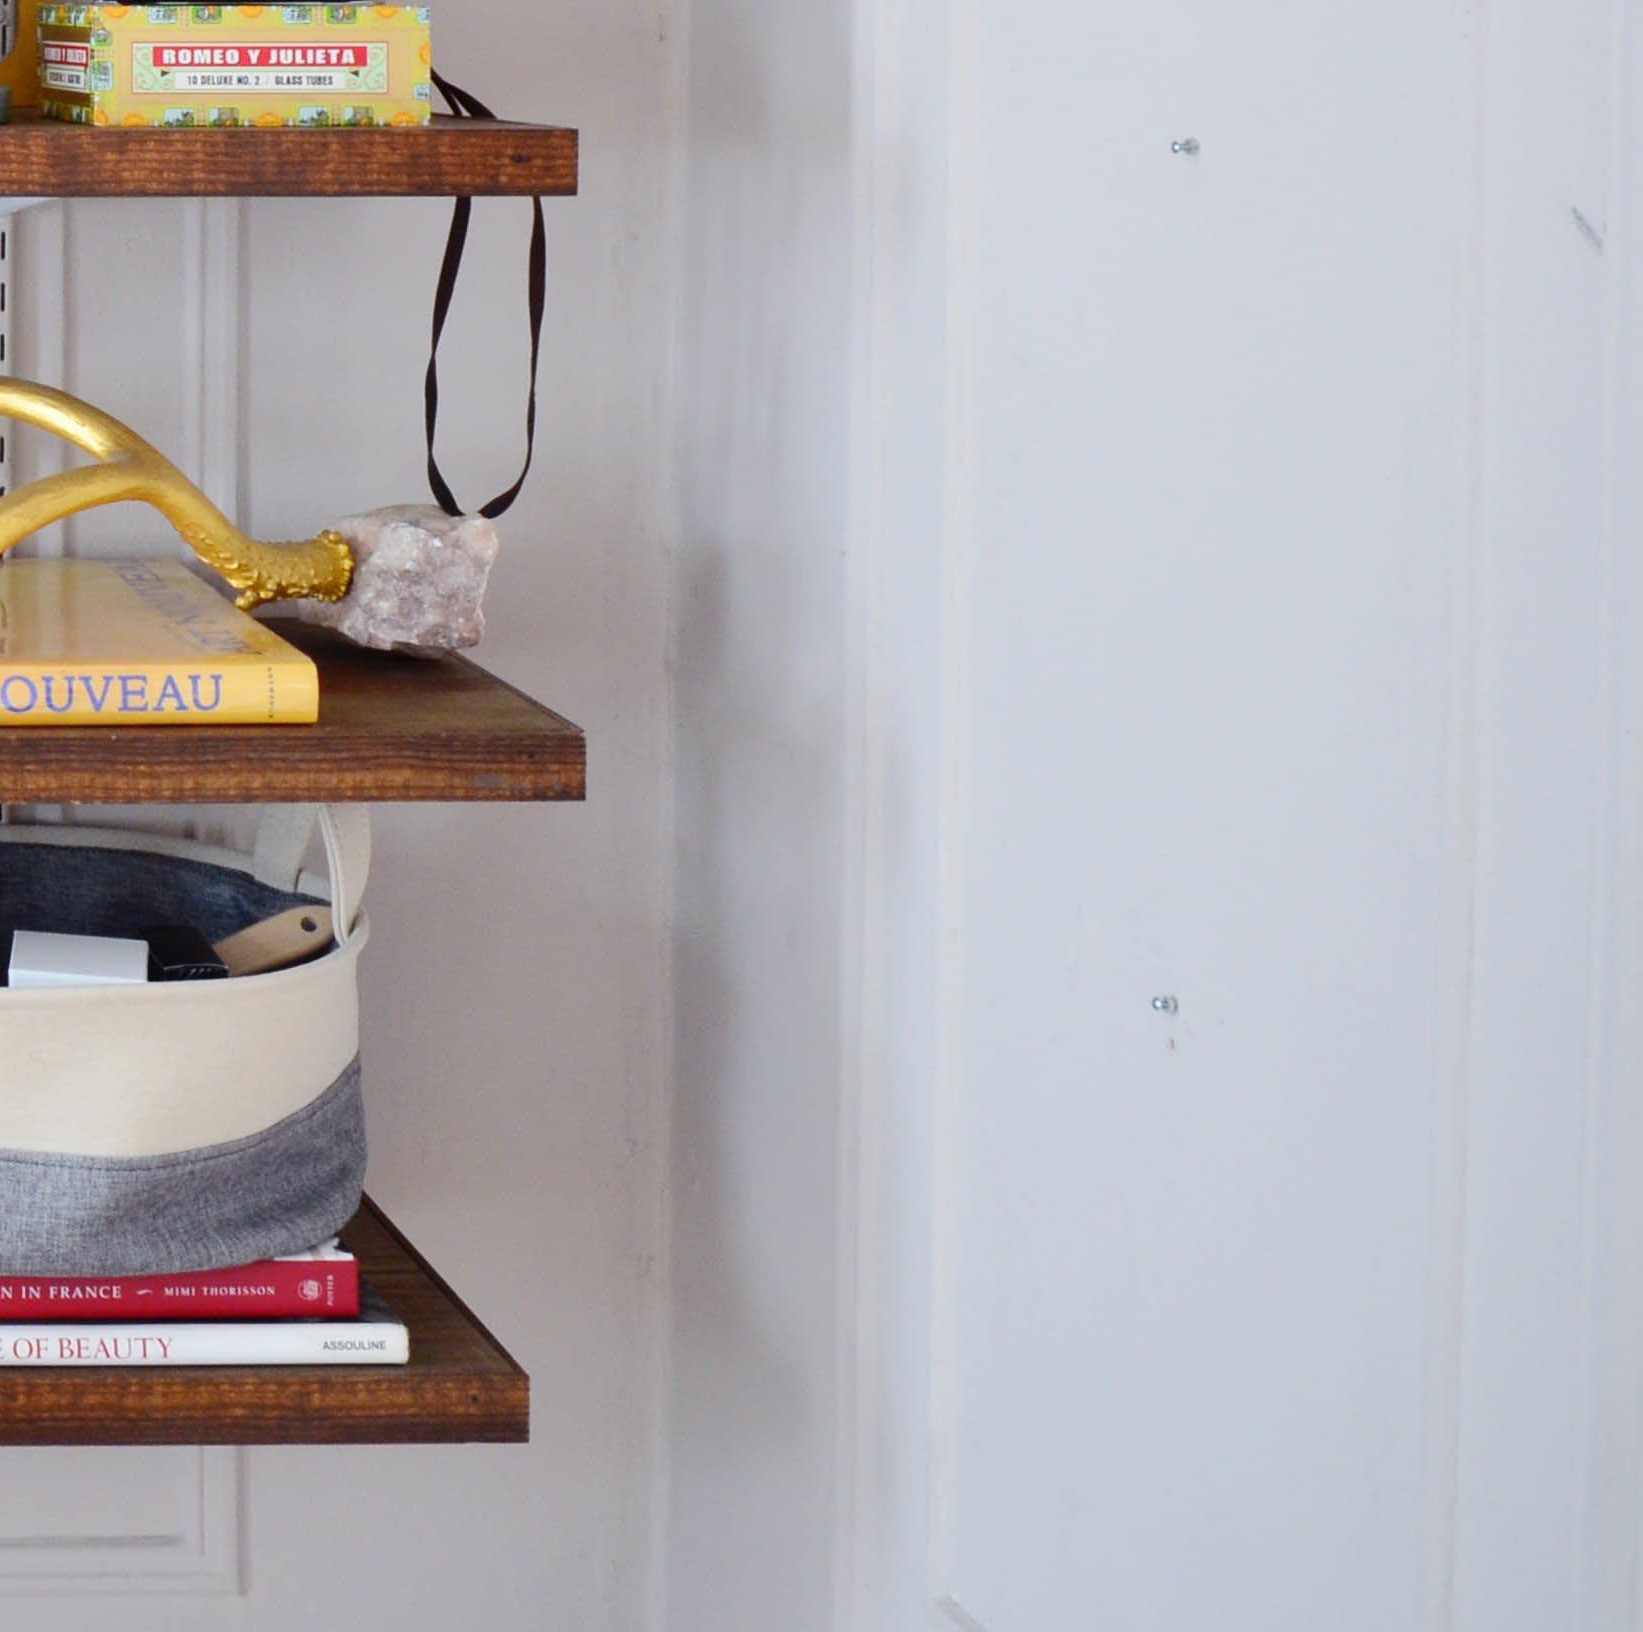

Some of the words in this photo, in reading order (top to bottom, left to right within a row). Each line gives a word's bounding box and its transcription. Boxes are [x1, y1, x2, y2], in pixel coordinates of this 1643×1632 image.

[162, 49, 241, 65] ROMEO
[247, 49, 262, 65] Y
[268, 49, 356, 65] JULIETA
[187, 76, 198, 86] 10
[201, 76, 234, 86] DELUXE
[236, 76, 253, 86] NO.
[254, 76, 261, 86] 2
[274, 76, 304, 86] GLASS
[306, 76, 334, 86] TUBES
[21, 1286, 41, 1299] IN
[48, 1285, 122, 1299] FRANCE
[164, 1286, 196, 1297] MIMI
[202, 1285, 276, 1297] THORISSON
[12, 1338, 50, 1360] OF
[58, 1337, 173, 1360] BEAUTY
[322, 1339, 388, 1351] ASSOULINE
